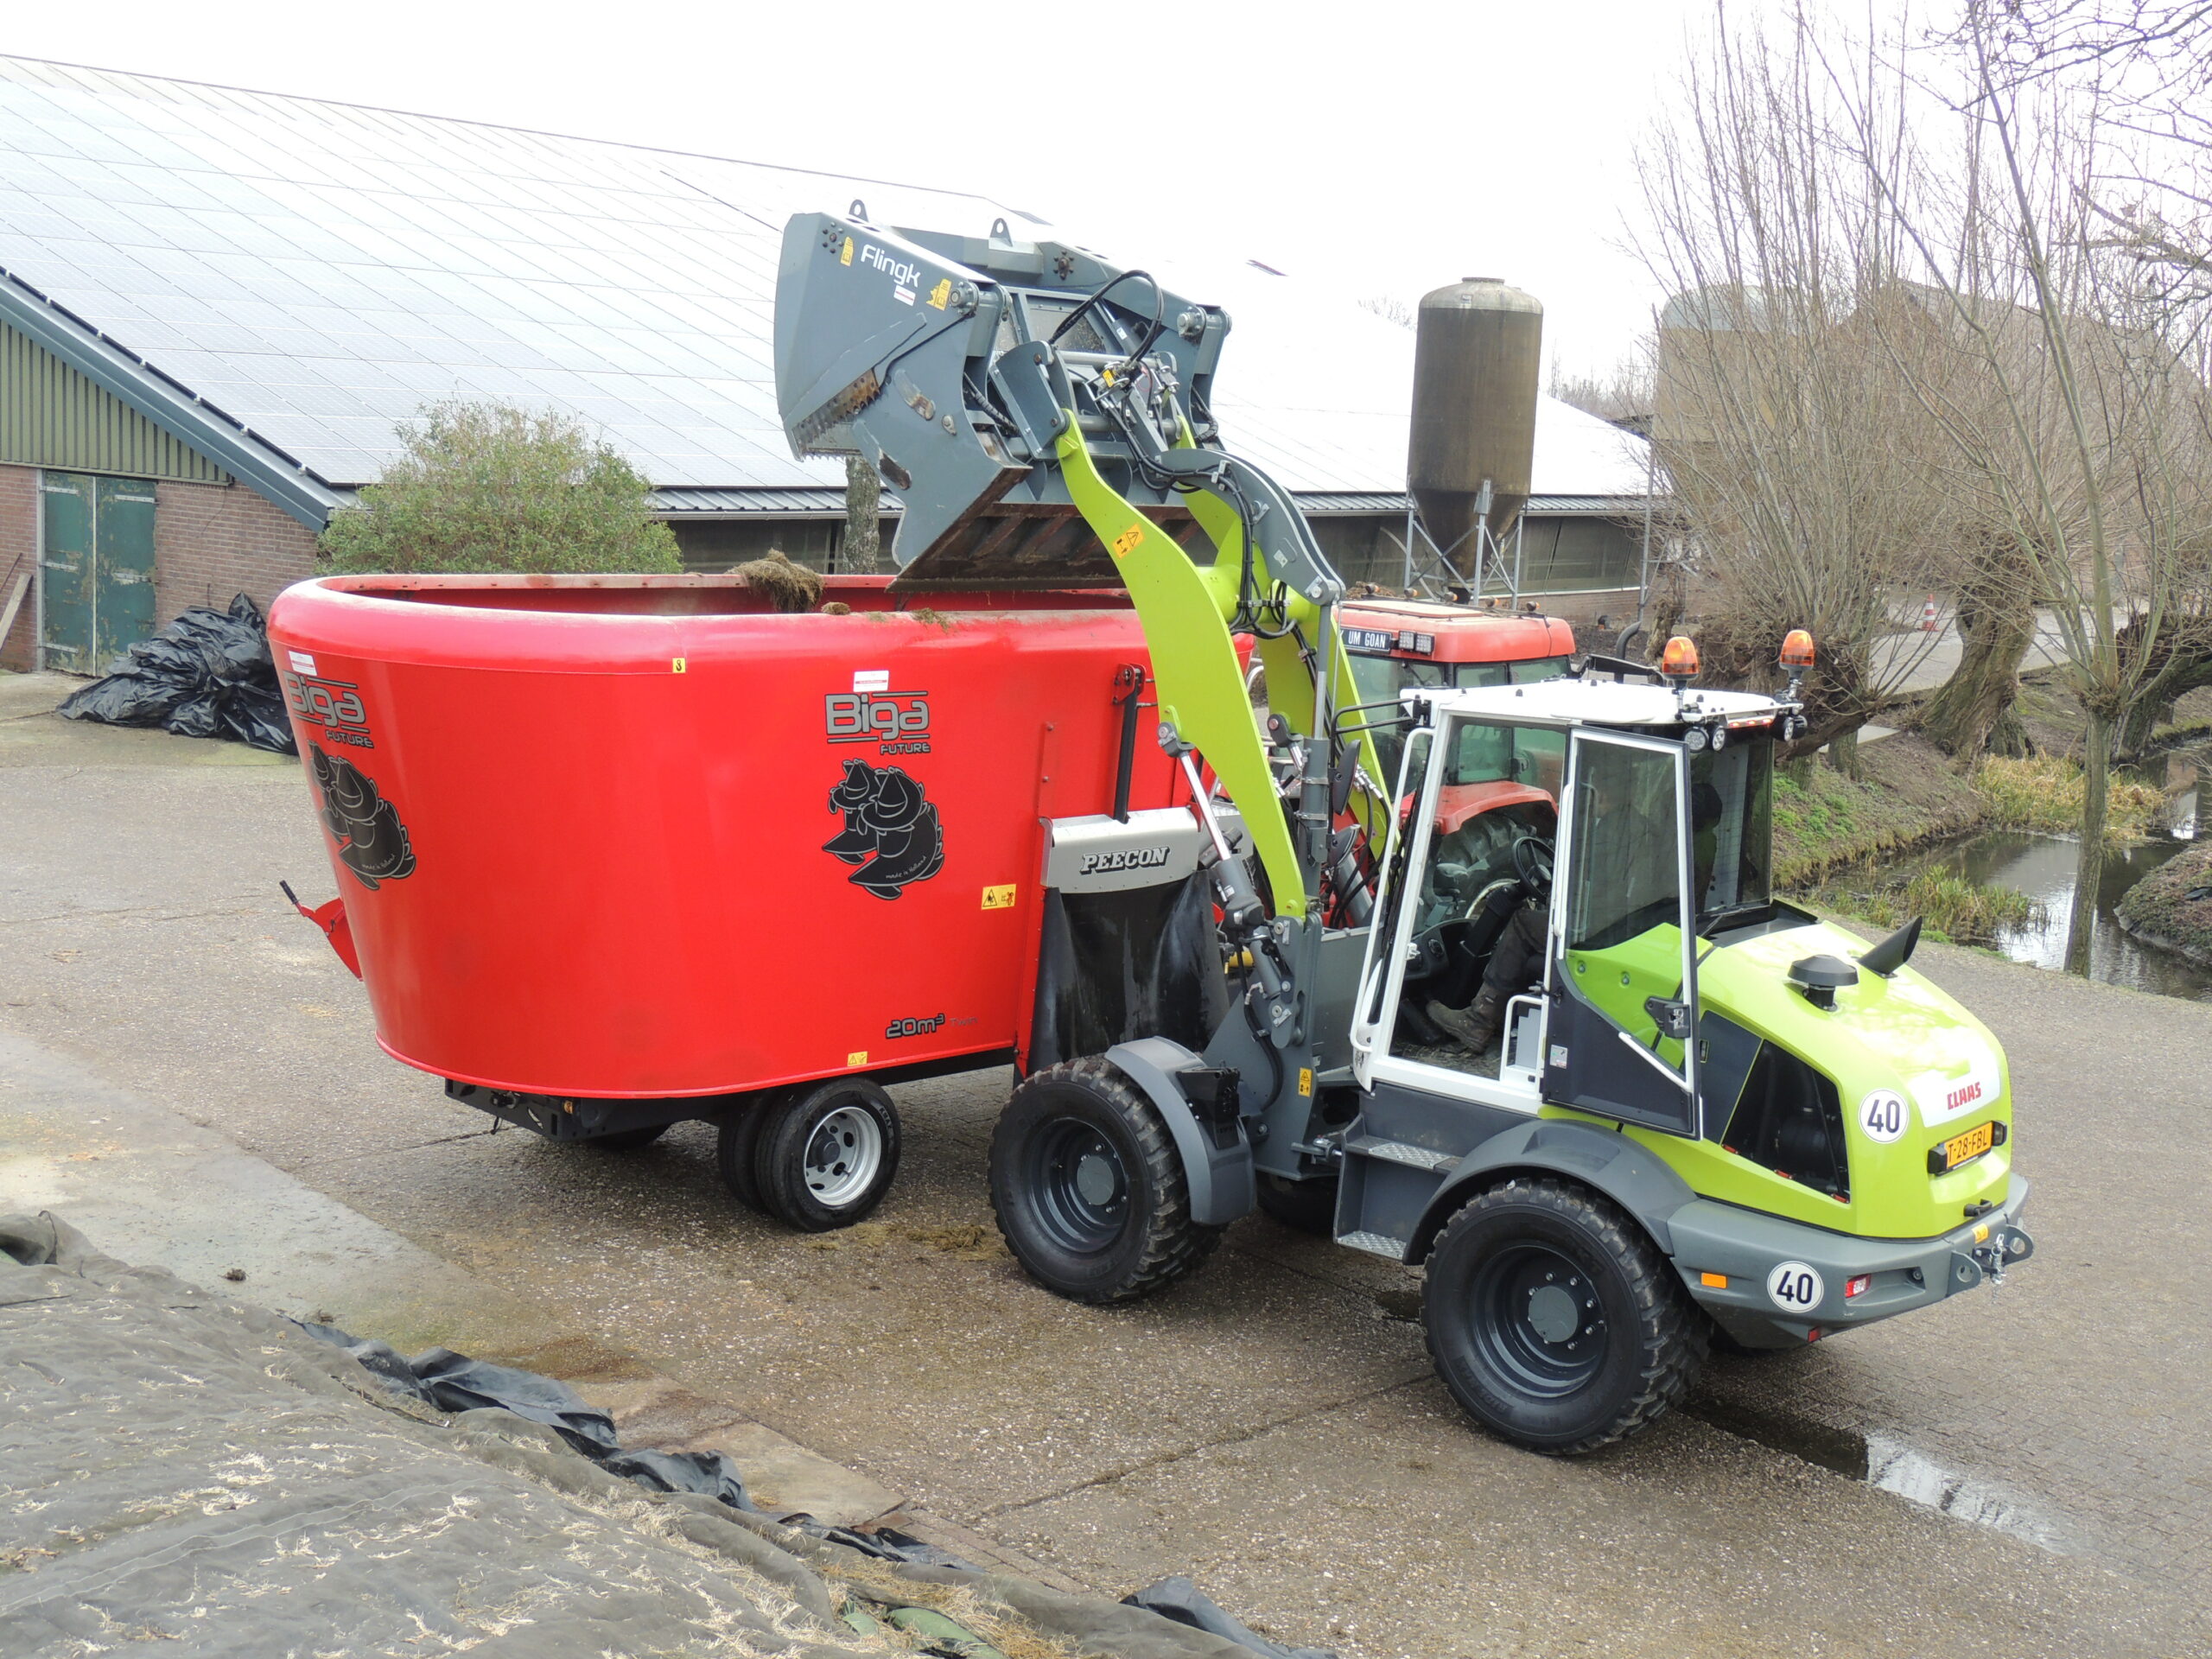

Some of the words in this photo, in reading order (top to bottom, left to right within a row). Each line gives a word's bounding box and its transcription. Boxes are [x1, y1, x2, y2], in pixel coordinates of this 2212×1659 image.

[861, 244, 921, 288] Flingk
[1348, 631, 1361, 645] UM
[1365, 632, 1386, 648] GOAN
[283, 670, 366, 728] Biga
[825, 692, 929, 741] Biga
[325, 729, 374, 748] FUTURE
[880, 742, 931, 755] FUTURE
[1079, 846, 1170, 875] PEECON
[1947, 1082, 1981, 1110] CLAAS
[1867, 1099, 1900, 1134] 40
[1948, 1129, 1987, 1163] T-28-FBL
[1777, 1270, 1814, 1305] 40
